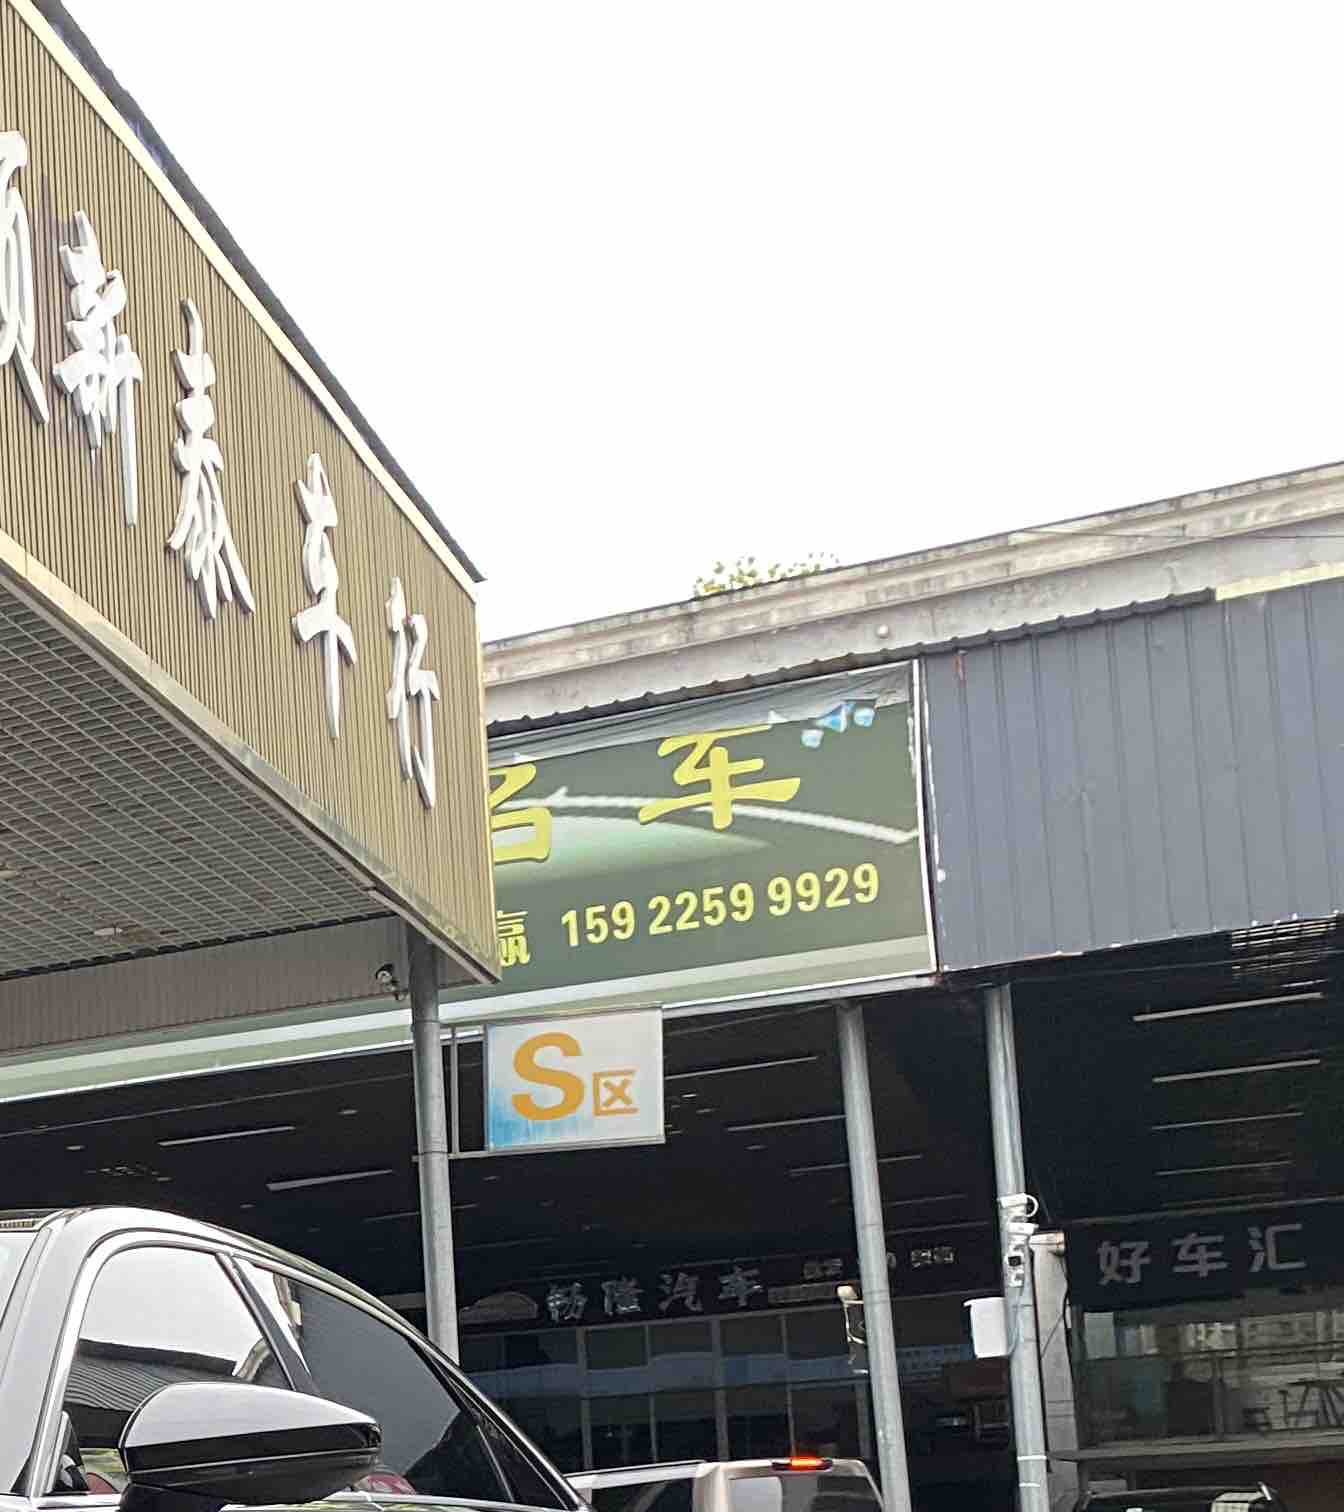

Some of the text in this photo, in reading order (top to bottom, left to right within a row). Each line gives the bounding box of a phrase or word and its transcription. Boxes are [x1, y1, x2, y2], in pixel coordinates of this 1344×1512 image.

[560, 901, 636, 947] 159
[647, 882, 755, 936] 2259
[766, 862, 880, 917] 9929
[511, 1031, 639, 1122] S区
[1097, 1223, 1308, 1286] 好车汇
